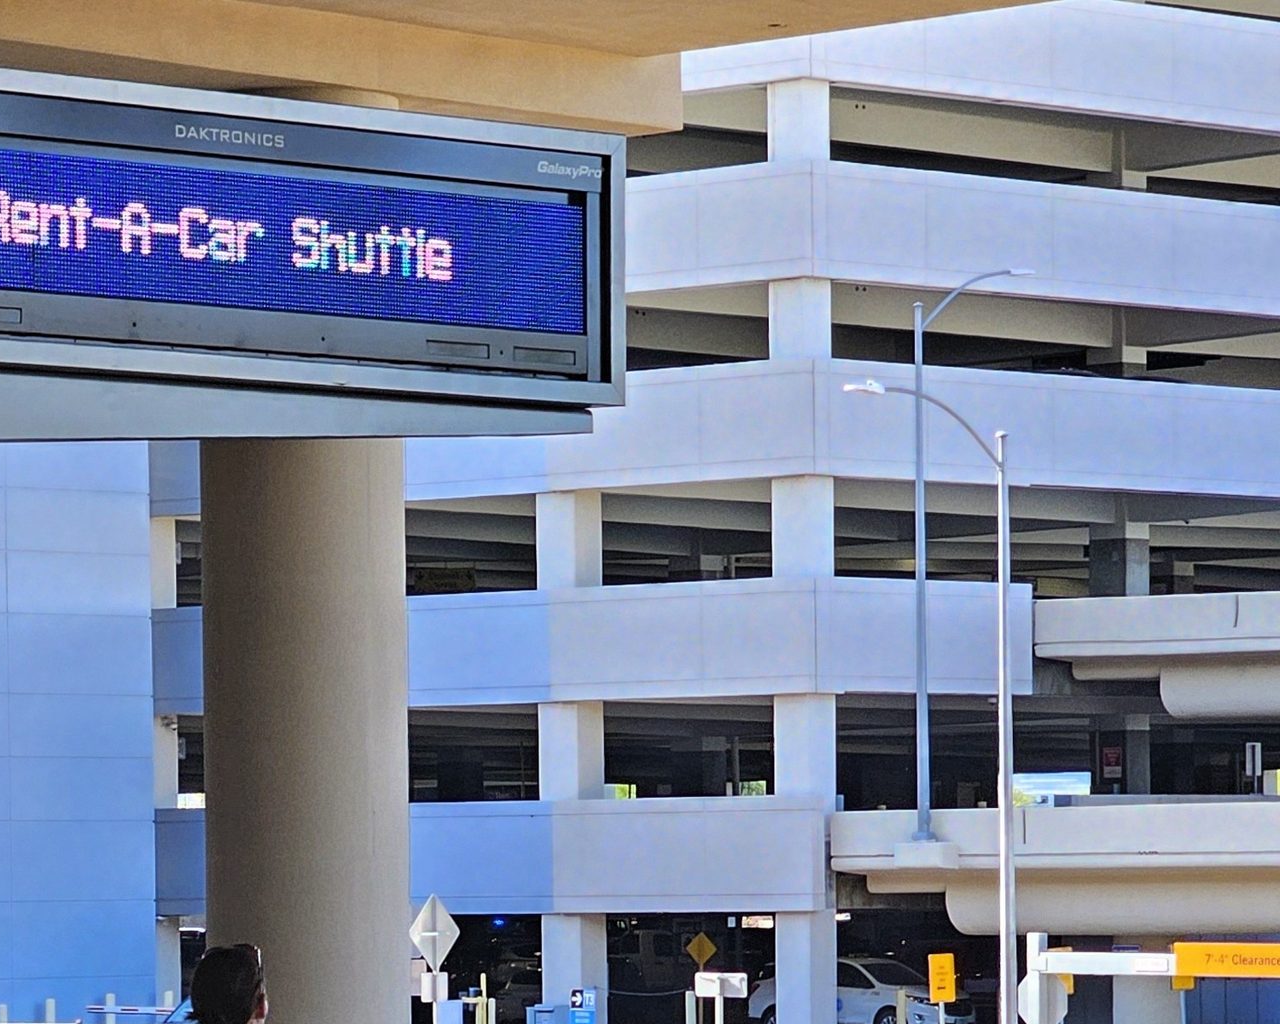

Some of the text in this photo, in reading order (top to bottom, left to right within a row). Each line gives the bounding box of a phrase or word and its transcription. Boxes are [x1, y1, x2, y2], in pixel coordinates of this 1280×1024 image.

[175, 124, 285, 148] DAKTRONICS
[537, 160, 603, 180] GalaxyPro
[291, 217, 454, 281] Shuttle
